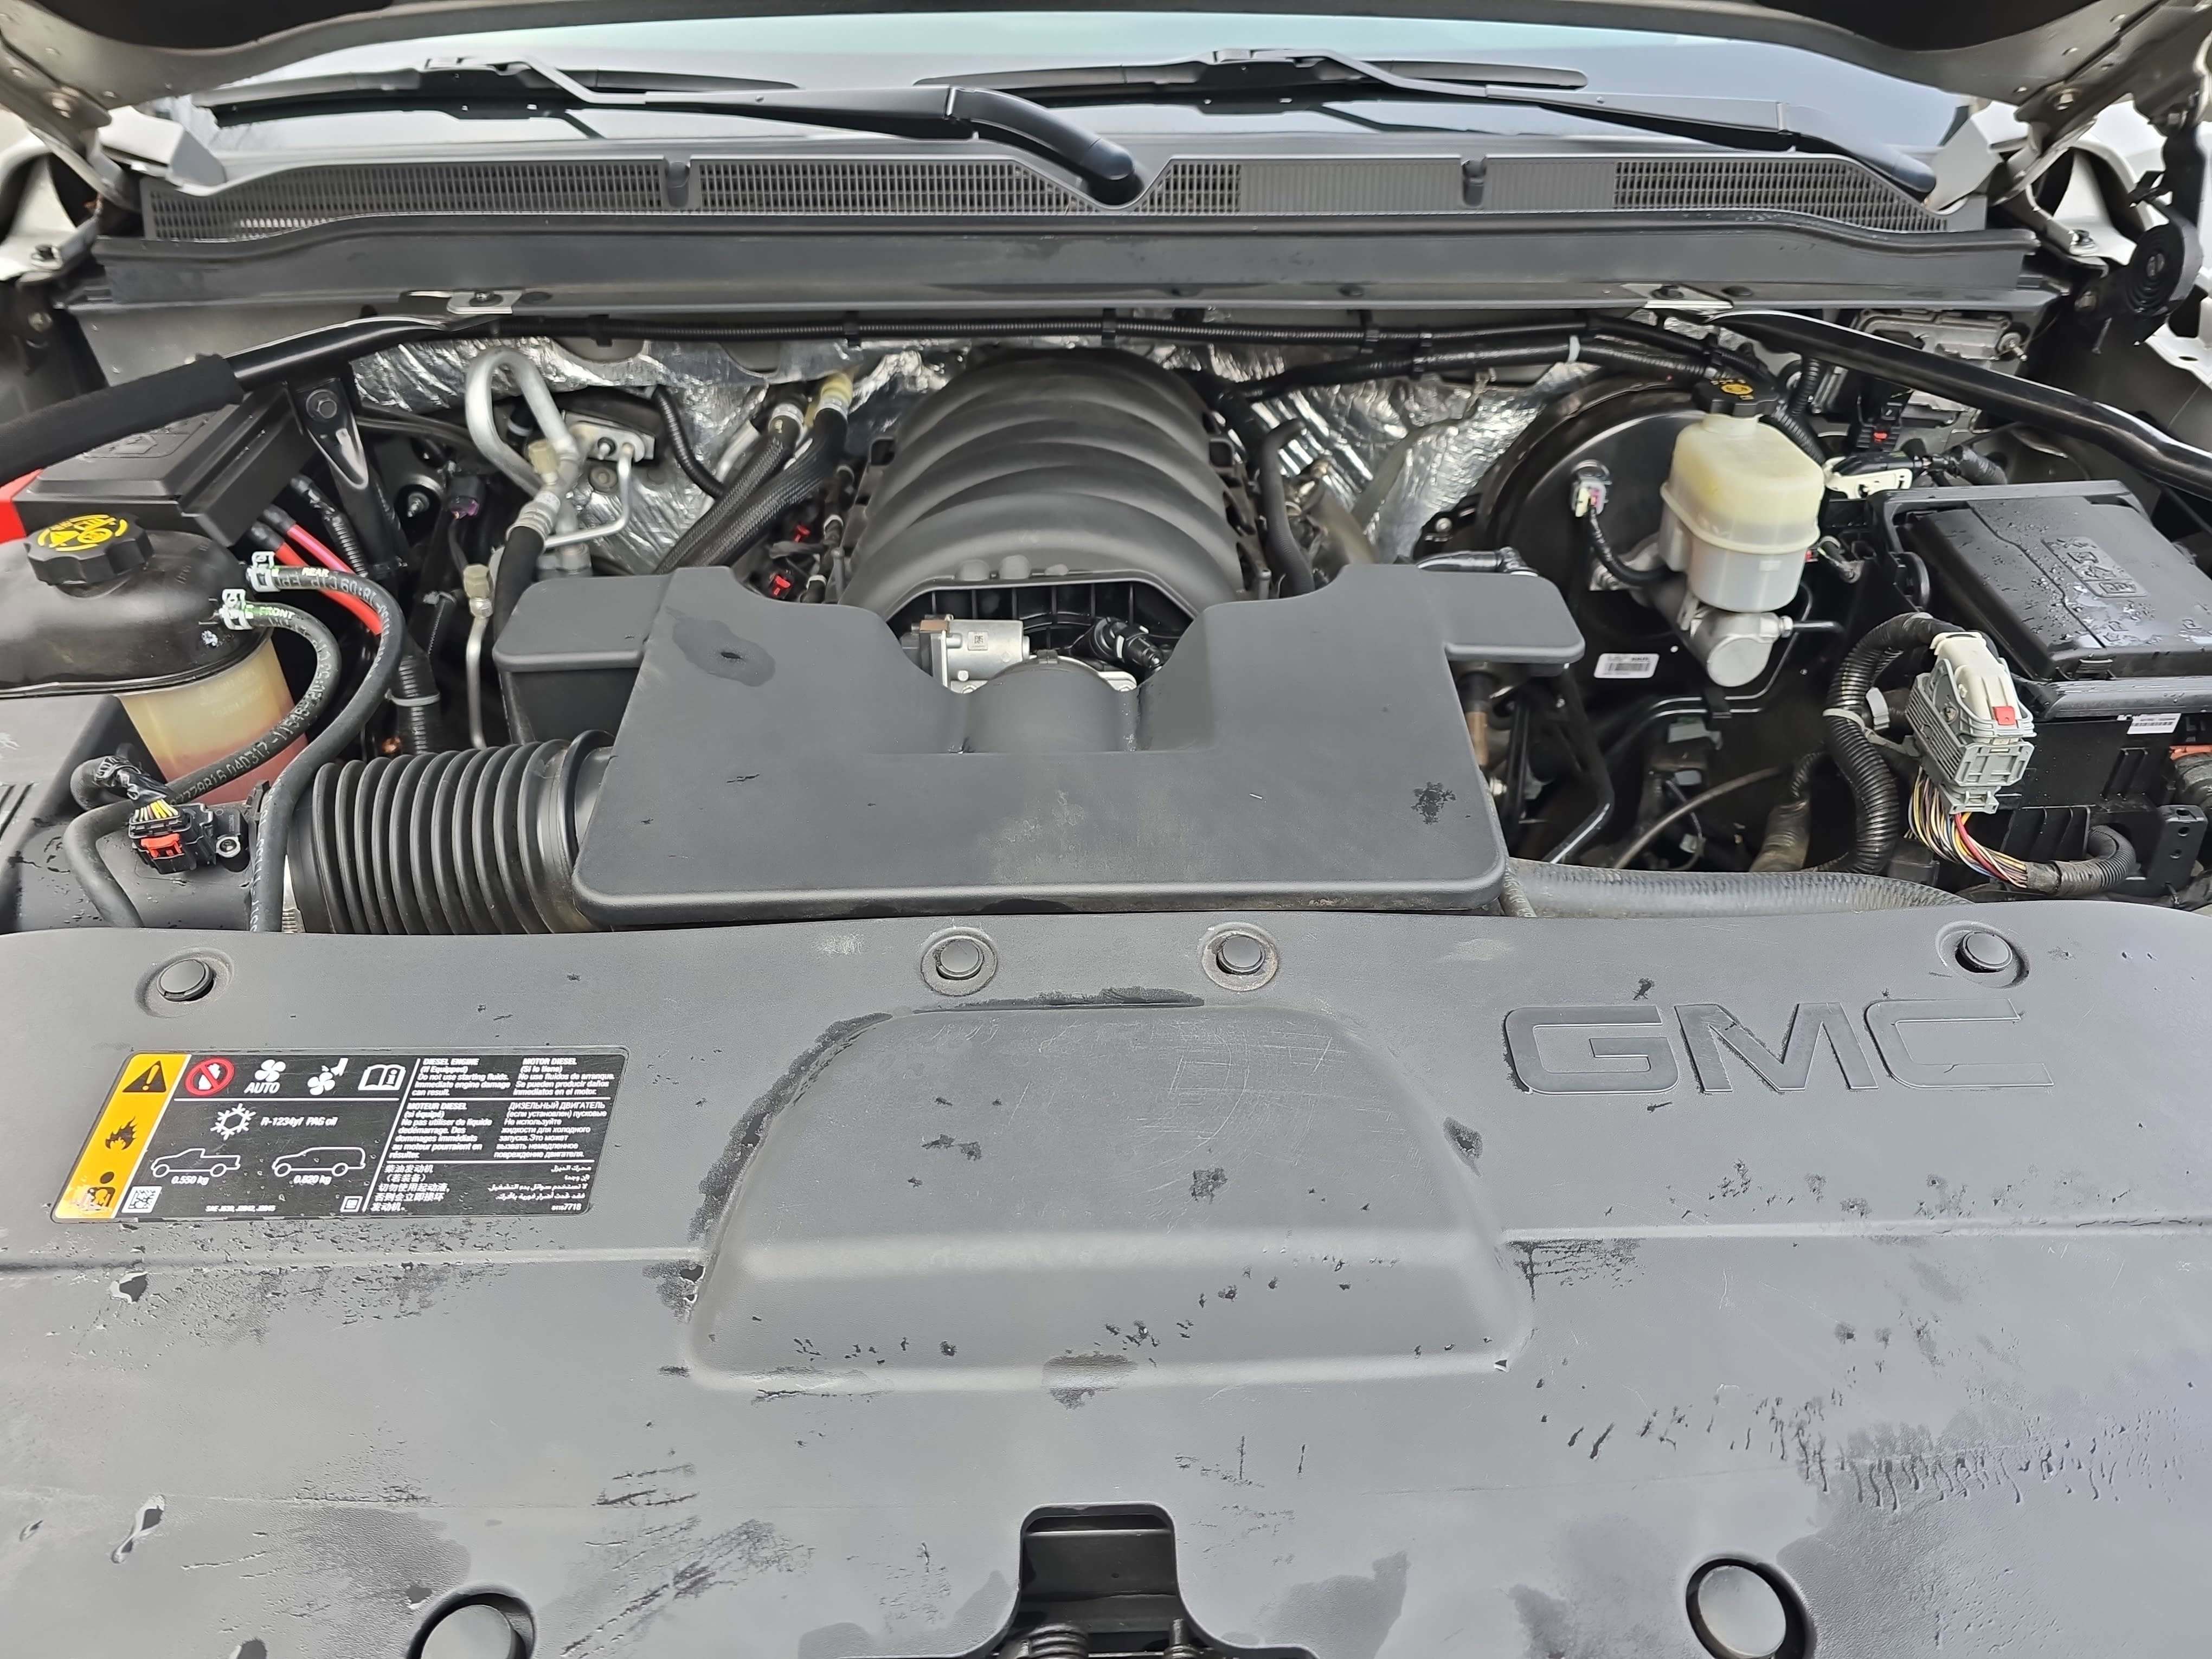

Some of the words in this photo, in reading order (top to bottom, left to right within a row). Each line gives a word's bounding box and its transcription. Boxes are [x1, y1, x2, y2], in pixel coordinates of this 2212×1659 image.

[301, 567, 329, 577] REAR
[1504, 999, 2054, 1095] GMC
[244, 1082, 280, 1094] AUTO
[509, 1101, 559, 1110] ДИЗЕЛЬНЫЙ
[560, 1102, 605, 1110] ДВИГАТЕЛЬ
[326, 1117, 338, 1126] oil
[467, 1118, 492, 1127] liquide
[395, 1135, 437, 1143] dommages
[431, 1143, 472, 1152] pourraient
[171, 1175, 197, 1184] 0.550
[197, 1176, 209, 1185] kg
[319, 1175, 332, 1185] kg
